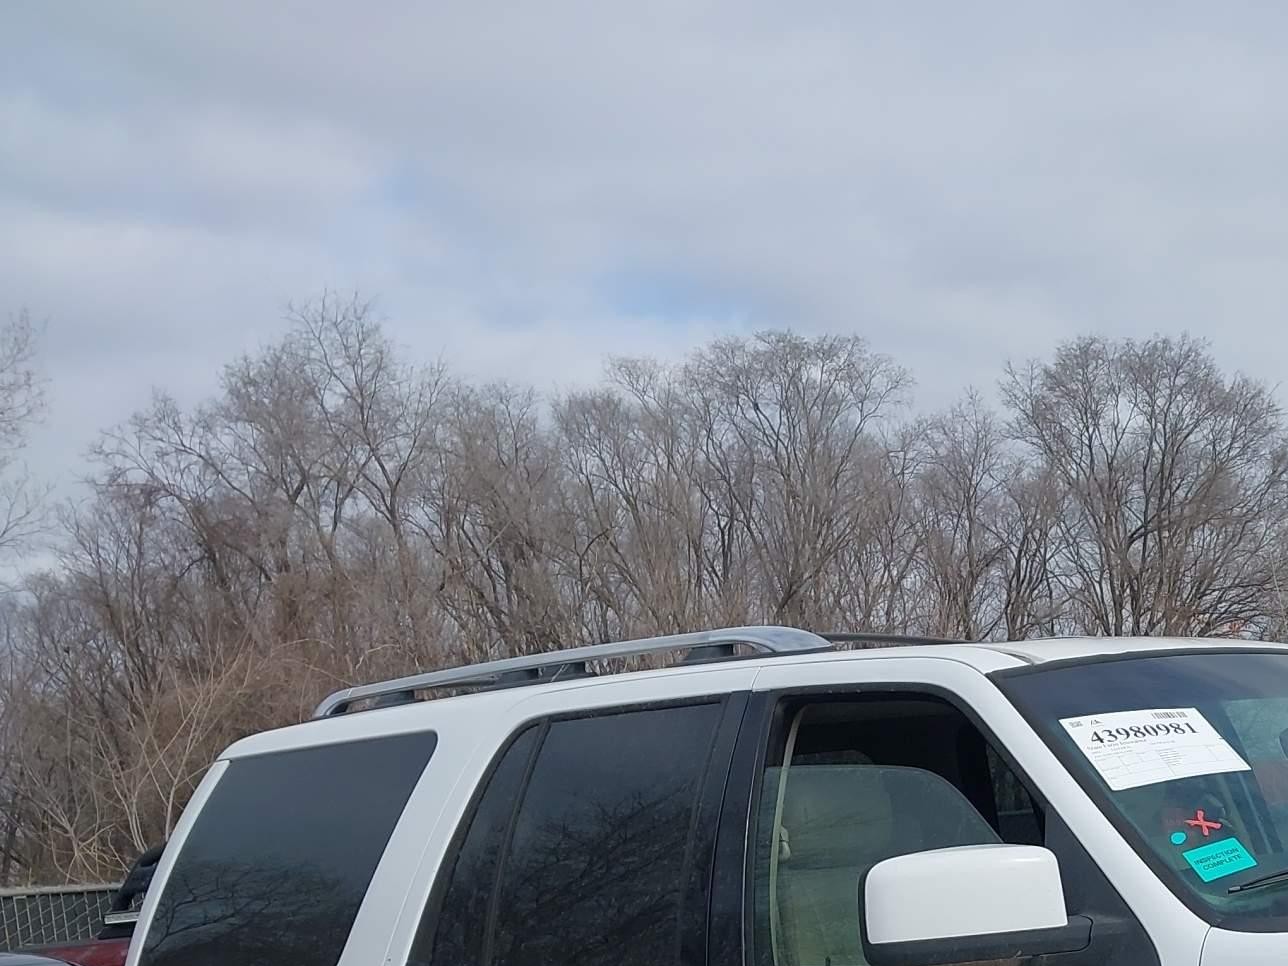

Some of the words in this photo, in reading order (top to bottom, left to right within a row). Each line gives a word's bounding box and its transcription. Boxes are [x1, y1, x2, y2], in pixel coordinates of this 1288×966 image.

[1091, 722, 1199, 743] 43980981
[1193, 847, 1240, 865] INSPECTION
[1202, 854, 1242, 871] COMPLETE
